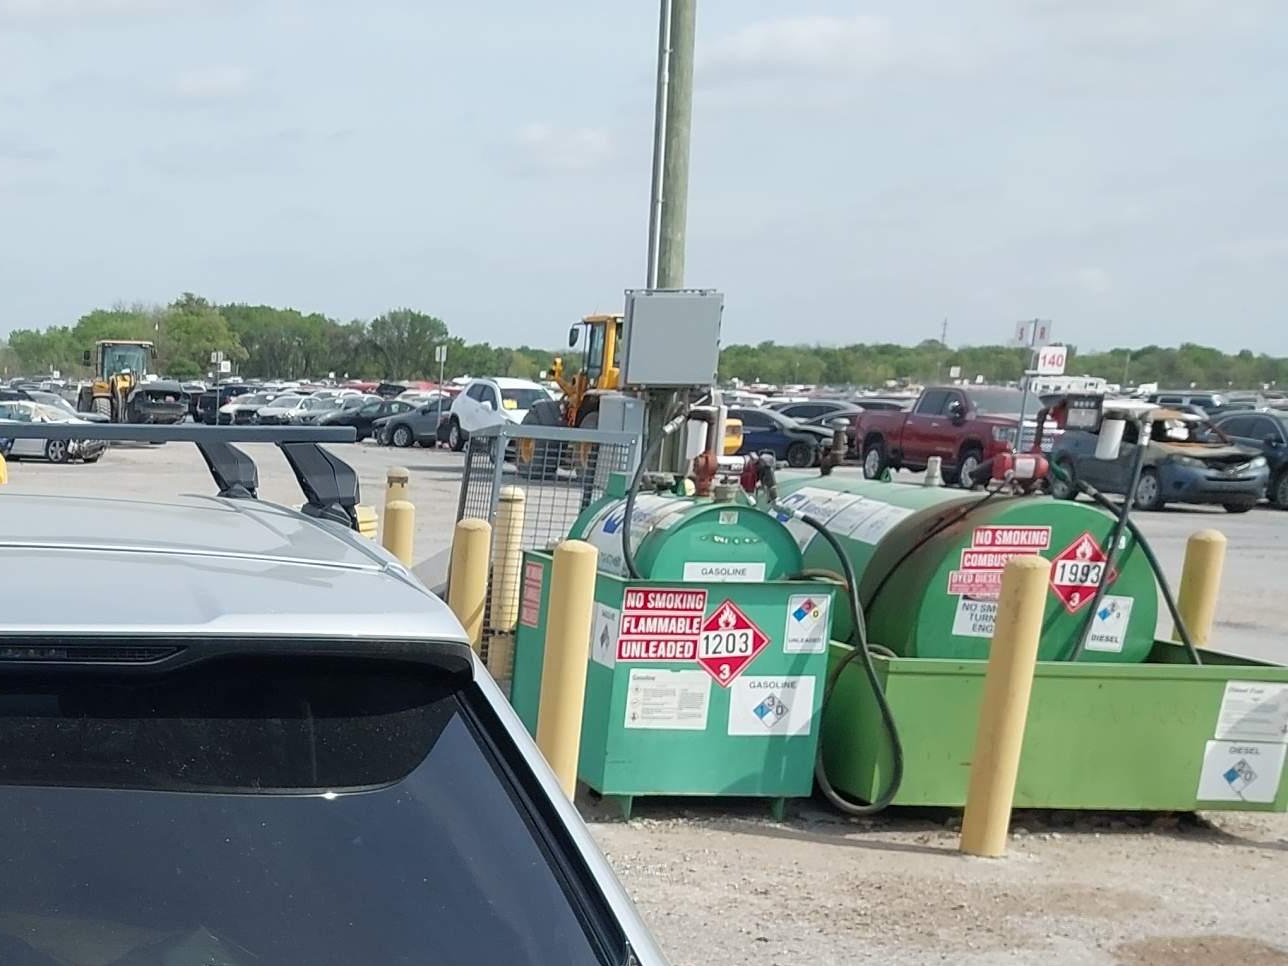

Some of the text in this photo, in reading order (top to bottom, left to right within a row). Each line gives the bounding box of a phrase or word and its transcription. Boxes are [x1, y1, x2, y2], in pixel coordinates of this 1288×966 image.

[1041, 353, 1064, 368] 140
[975, 530, 1048, 545] NO SMOKING
[700, 567, 748, 577] GASOLINE
[1059, 562, 1102, 584] 1993
[626, 591, 704, 610] NO SMOKING
[1070, 591, 1081, 607] 3
[623, 616, 701, 634] FLAMMABLE
[972, 624, 993, 634] ENG
[621, 641, 694, 659] UNLEADED
[703, 632, 750, 655] 1203
[719, 663, 731, 680] 3
[749, 680, 797, 689] GASOLINE
